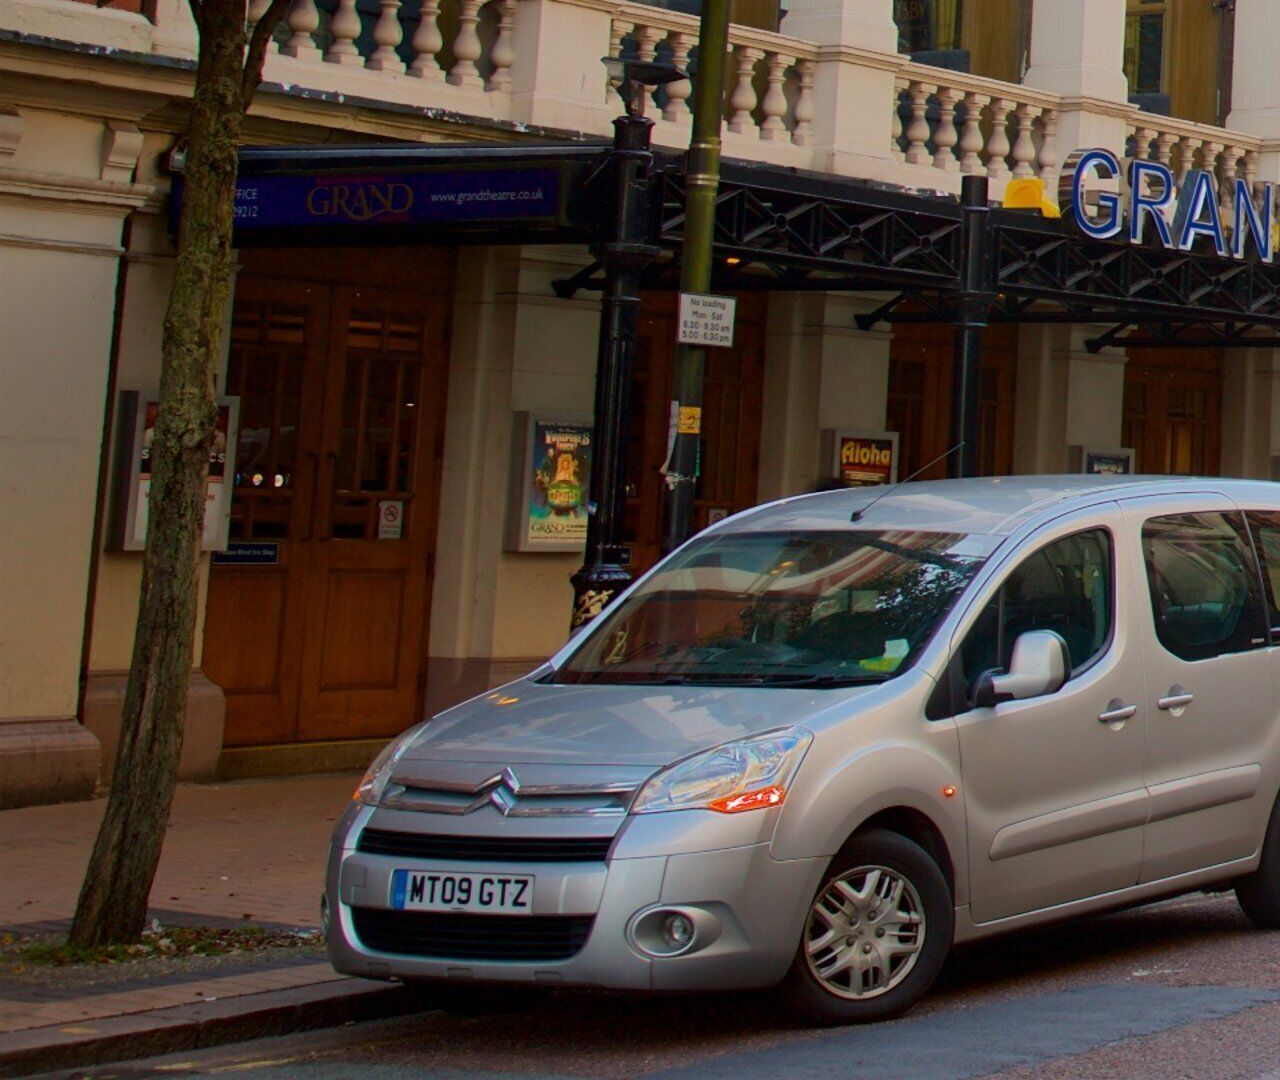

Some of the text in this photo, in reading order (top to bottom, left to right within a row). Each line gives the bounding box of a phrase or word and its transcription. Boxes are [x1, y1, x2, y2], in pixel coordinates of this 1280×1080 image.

[306, 183, 544, 221] GRAND www.grandtheatre.co.uk
[690, 298, 726, 310] No loading
[711, 312, 723, 321] Sat
[842, 440, 891, 466] Aloha
[409, 875, 529, 907] MT09 GTZ
